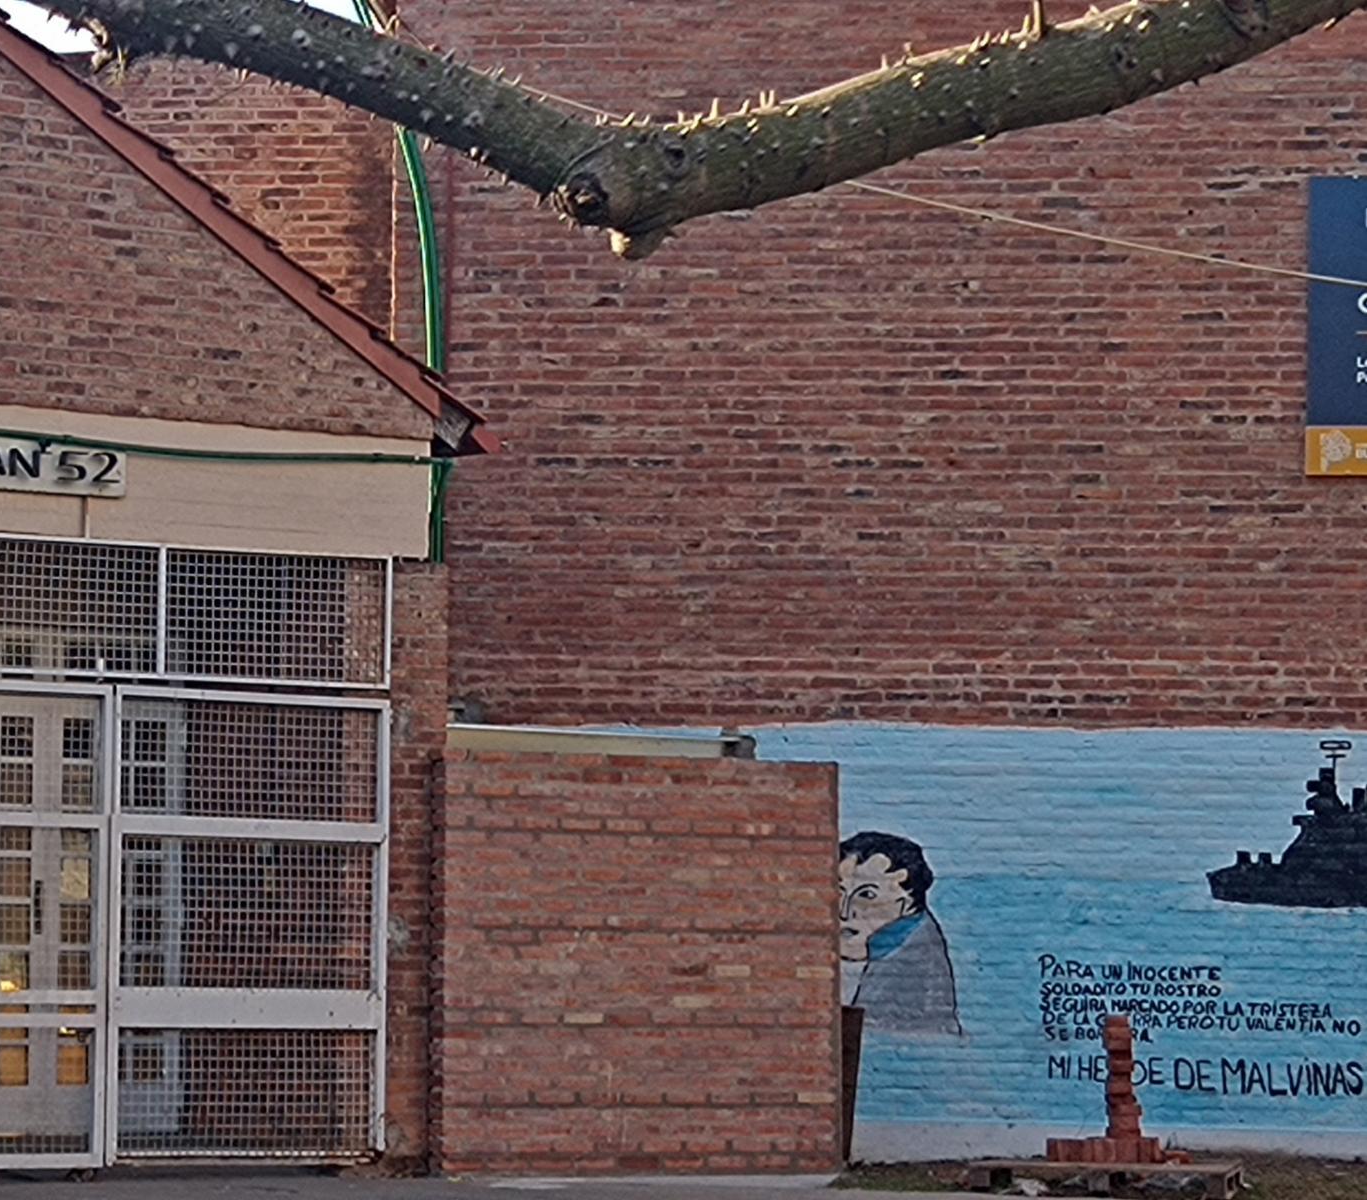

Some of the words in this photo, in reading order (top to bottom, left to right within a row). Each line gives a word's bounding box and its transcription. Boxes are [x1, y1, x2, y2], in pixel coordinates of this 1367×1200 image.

[57, 450, 121, 484] 52
[1038, 953, 1094, 979] PARA
[1101, 964, 1123, 980] UN
[1128, 961, 1222, 982] INOCENTE
[1039, 981, 1127, 997] SOLDADITO
[1129, 983, 1151, 996] TU
[1153, 983, 1222, 998] ROSTRO
[1039, 996, 1108, 1014] SEGUIRA
[1111, 999, 1180, 1015] MARCADO
[1182, 1000, 1218, 1015] POR
[1223, 1001, 1245, 1017] LA
[1246, 1000, 1333, 1018] TRISTEZA
[1042, 1011, 1067, 1026] DE
[1073, 1012, 1091, 1026] LA
[1095, 1013, 1162, 1028] GRRA
[1166, 1015, 1214, 1029] PERO
[1215, 1016, 1240, 1031] TU
[1332, 1020, 1362, 1037] NO
[1045, 1026, 1069, 1041] SE
[1048, 1055, 1071, 1079] MI
[1078, 1055, 1165, 1086] HEOE
[1174, 1058, 1217, 1092] DE
